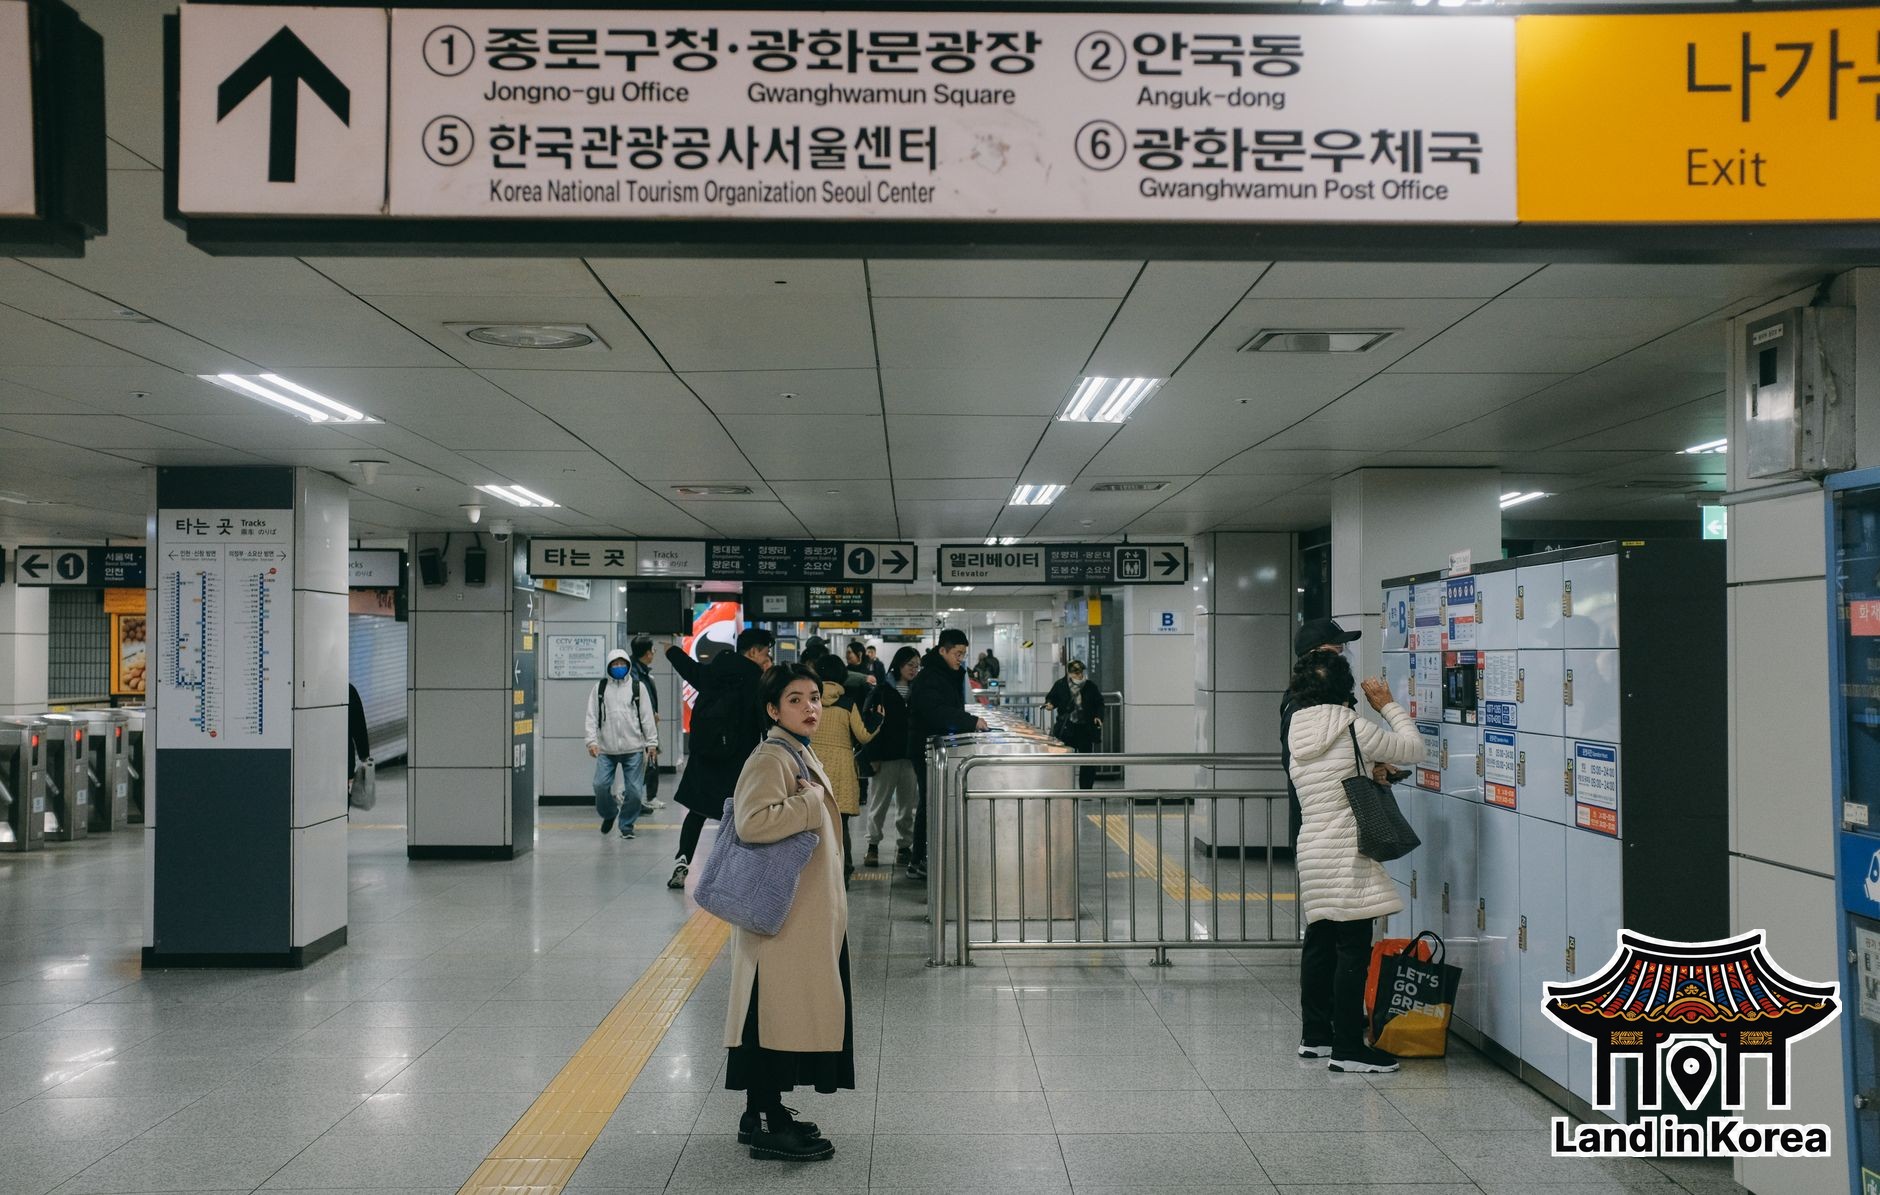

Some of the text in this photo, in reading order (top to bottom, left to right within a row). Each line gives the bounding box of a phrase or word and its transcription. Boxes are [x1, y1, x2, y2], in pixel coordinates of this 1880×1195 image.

[1132, 31, 1304, 78] 안국동
[484, 80, 689, 104] Jongno-gu Office
[747, 82, 1016, 107] Gwanghwamun Square
[1136, 85, 1286, 110] Anguk-dong
[489, 124, 937, 172] 한국관광공사서울센터
[1132, 127, 1483, 175] 광화문우체국
[1687, 148, 1767, 187] Exit
[490, 179, 935, 205] Korea National Tourism Organization Seoul Center
[1139, 177, 1449, 202] Gwanghwamun Post Office
[176, 518, 234, 536] 타는 곳
[241, 519, 266, 527] Tracks
[544, 547, 625, 567] 타는 곳
[653, 550, 679, 559] Tracks
[950, 553, 1039, 568] 엘리베이터
[1161, 612, 1174, 627] B
[1393, 979, 1418, 996] GO
[1396, 965, 1439, 988] LET'S
[1391, 993, 1446, 1018] GREEN
